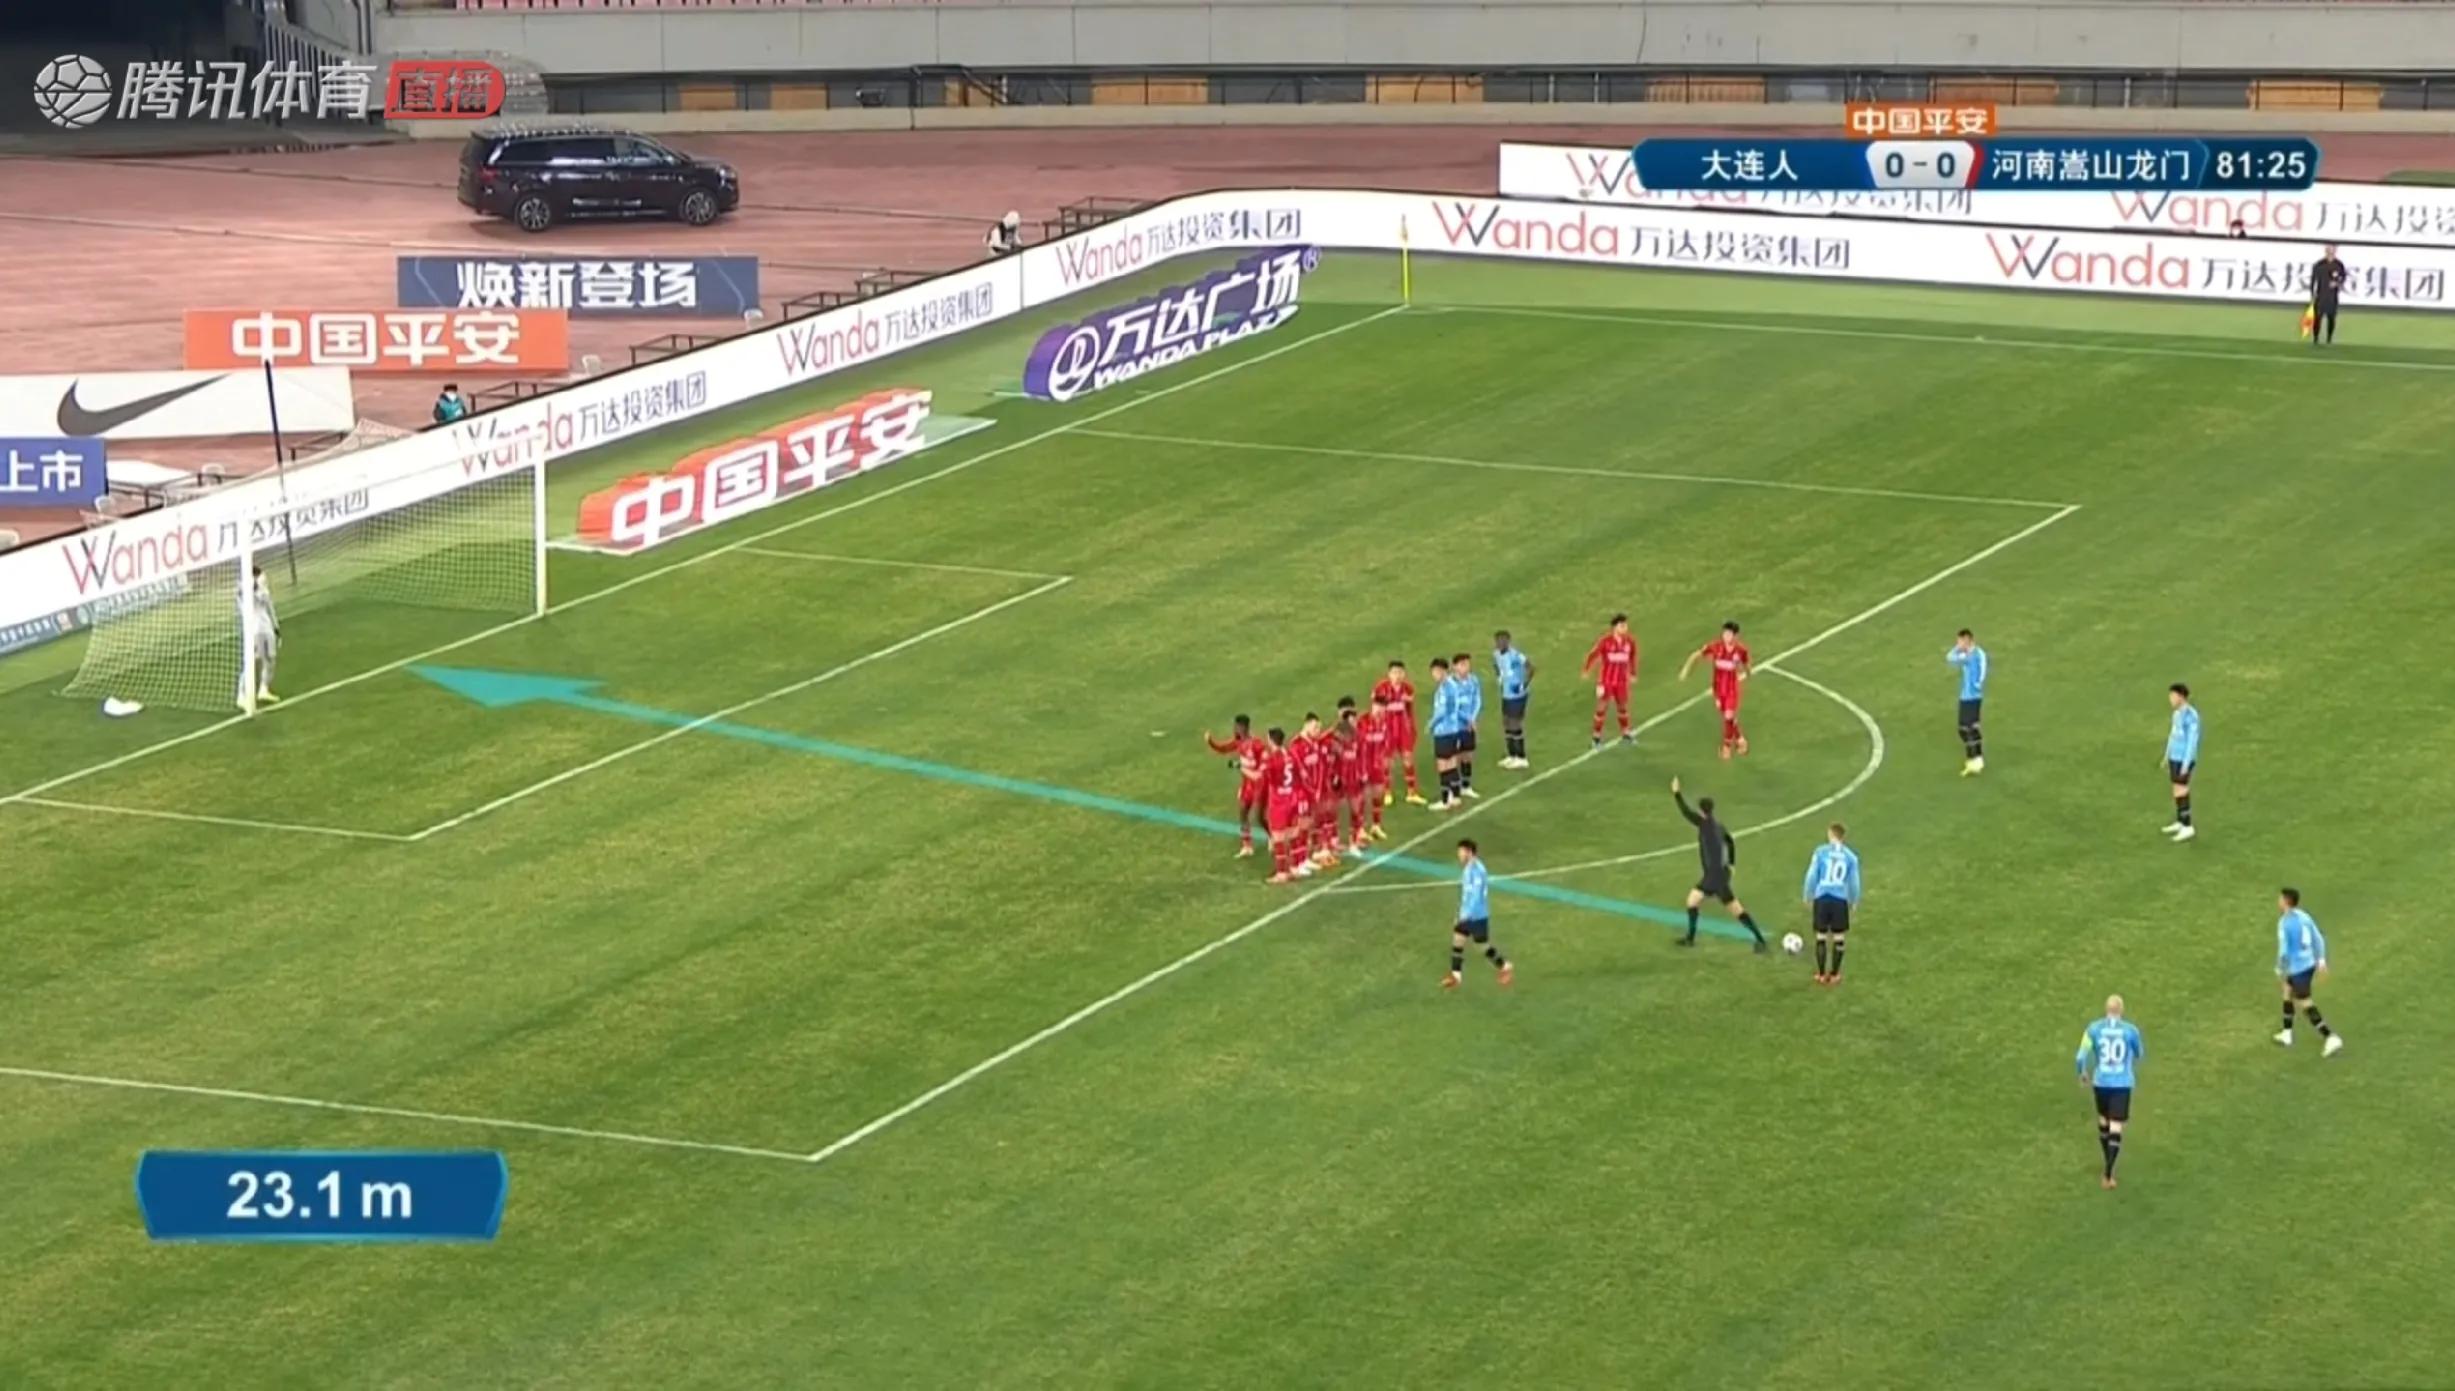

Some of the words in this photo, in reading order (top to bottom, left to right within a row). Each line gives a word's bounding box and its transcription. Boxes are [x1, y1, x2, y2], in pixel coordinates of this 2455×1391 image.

[1431, 201, 1619, 256] Wanda
[1630, 224, 1851, 270] 万达投资集团
[2111, 190, 2303, 231] Wanda
[1055, 224, 1143, 287] Wanda
[1147, 208, 1301, 256] 万达投资集团
[1986, 233, 2190, 289] Wanda
[455, 261, 697, 309] 焕新登场
[1098, 249, 1301, 370] 万达广场
[231, 311, 520, 366] 中国平安
[775, 307, 880, 378] Wanda
[884, 281, 993, 346] 万达投资集团
[1094, 340, 1200, 390] WANDA
[578, 370, 707, 442] 万达投资集团
[0, 449, 83, 493] 上市
[610, 389, 933, 545] 中国平安
[61, 524, 209, 595] Wanda
[1825, 858, 1847, 886] 10
[2099, 1037, 2126, 1064] 30
